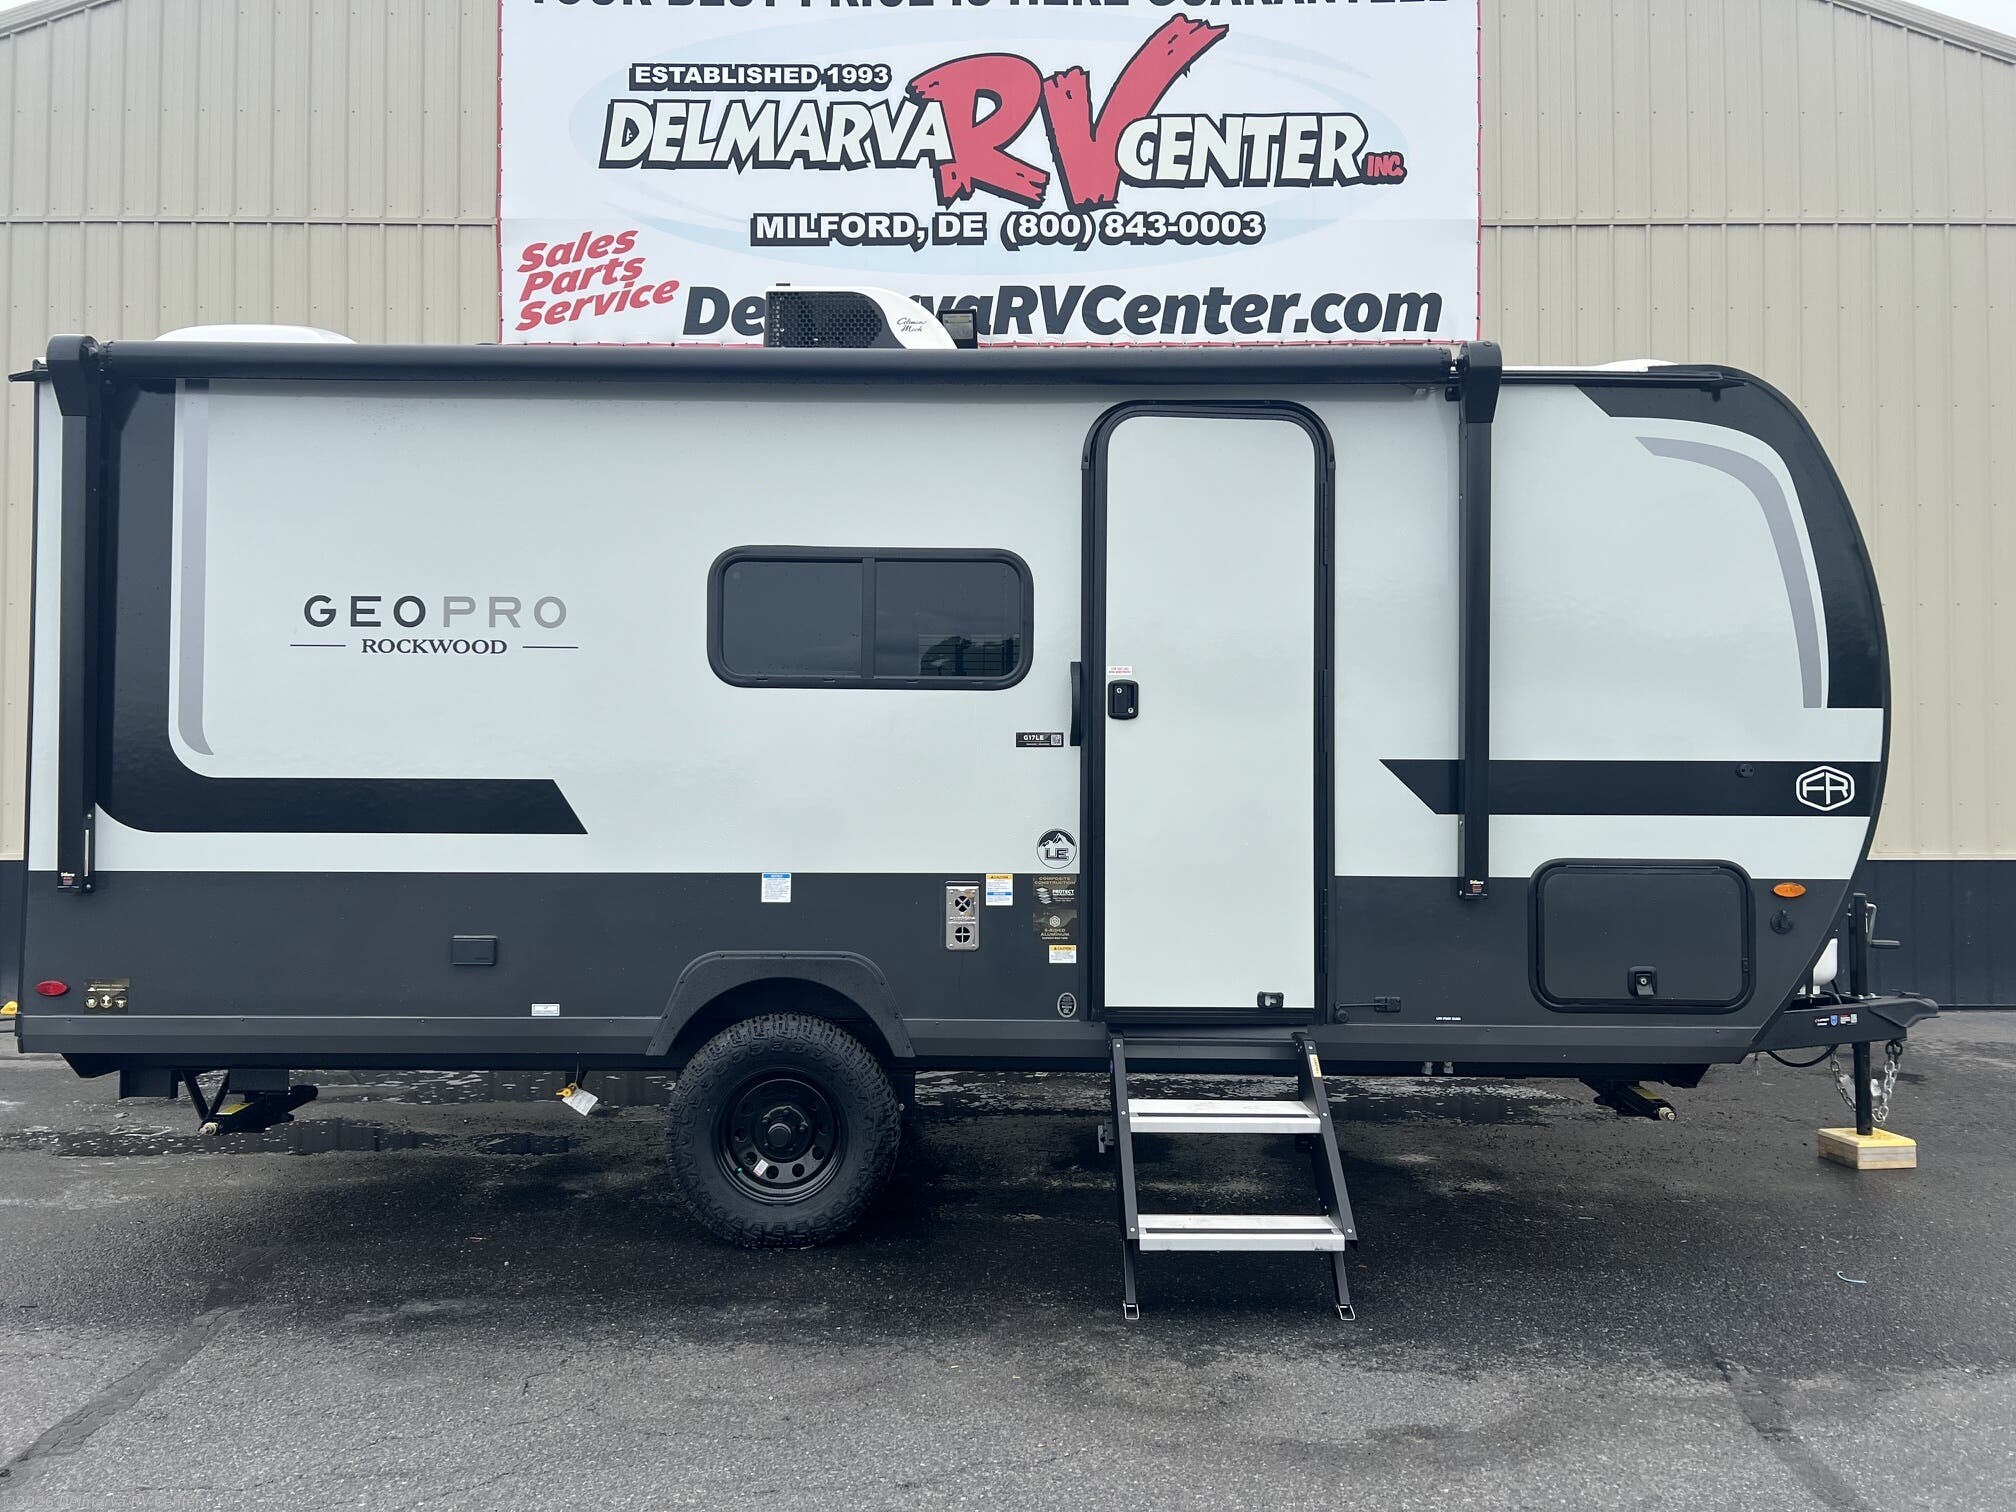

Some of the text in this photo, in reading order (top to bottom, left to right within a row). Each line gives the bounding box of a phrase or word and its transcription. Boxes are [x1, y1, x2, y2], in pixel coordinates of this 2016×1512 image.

[632, 65, 890, 87] ESTABLISHED 1993
[601, 14, 1404, 208] DELMARVA RV CENTER INC.
[754, 213, 1265, 245] MILFORD, DE (800) 843-0003
[517, 230, 638, 272] Sales
[520, 257, 646, 302] Parts
[515, 280, 679, 331] Service
[361, 638, 508, 654] ROCKWOOD
[1044, 847, 1069, 861] LE
